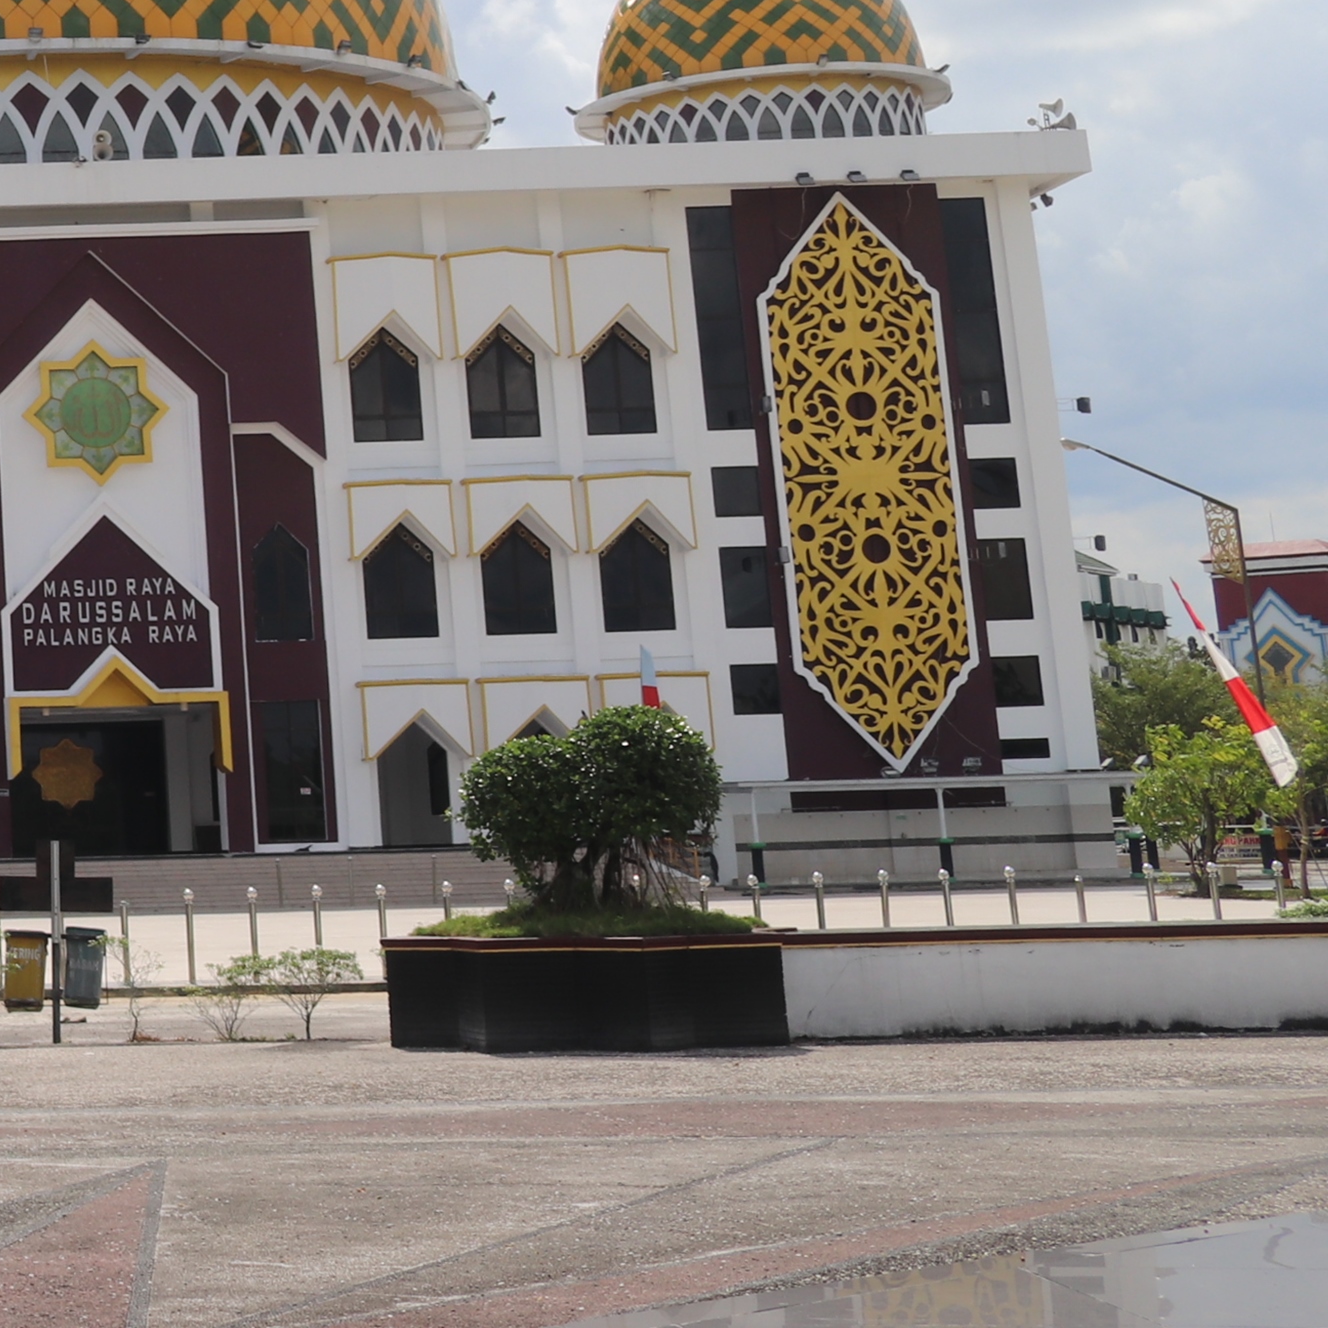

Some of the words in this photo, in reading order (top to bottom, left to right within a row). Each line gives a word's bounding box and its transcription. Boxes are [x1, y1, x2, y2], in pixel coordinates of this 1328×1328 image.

[44, 579, 118, 598] MASJID
[126, 577, 176, 596] RAYA
[22, 598, 197, 625] DARUSSALAM
[24, 626, 132, 646] PALANGKA
[148, 624, 198, 644] RAYA
